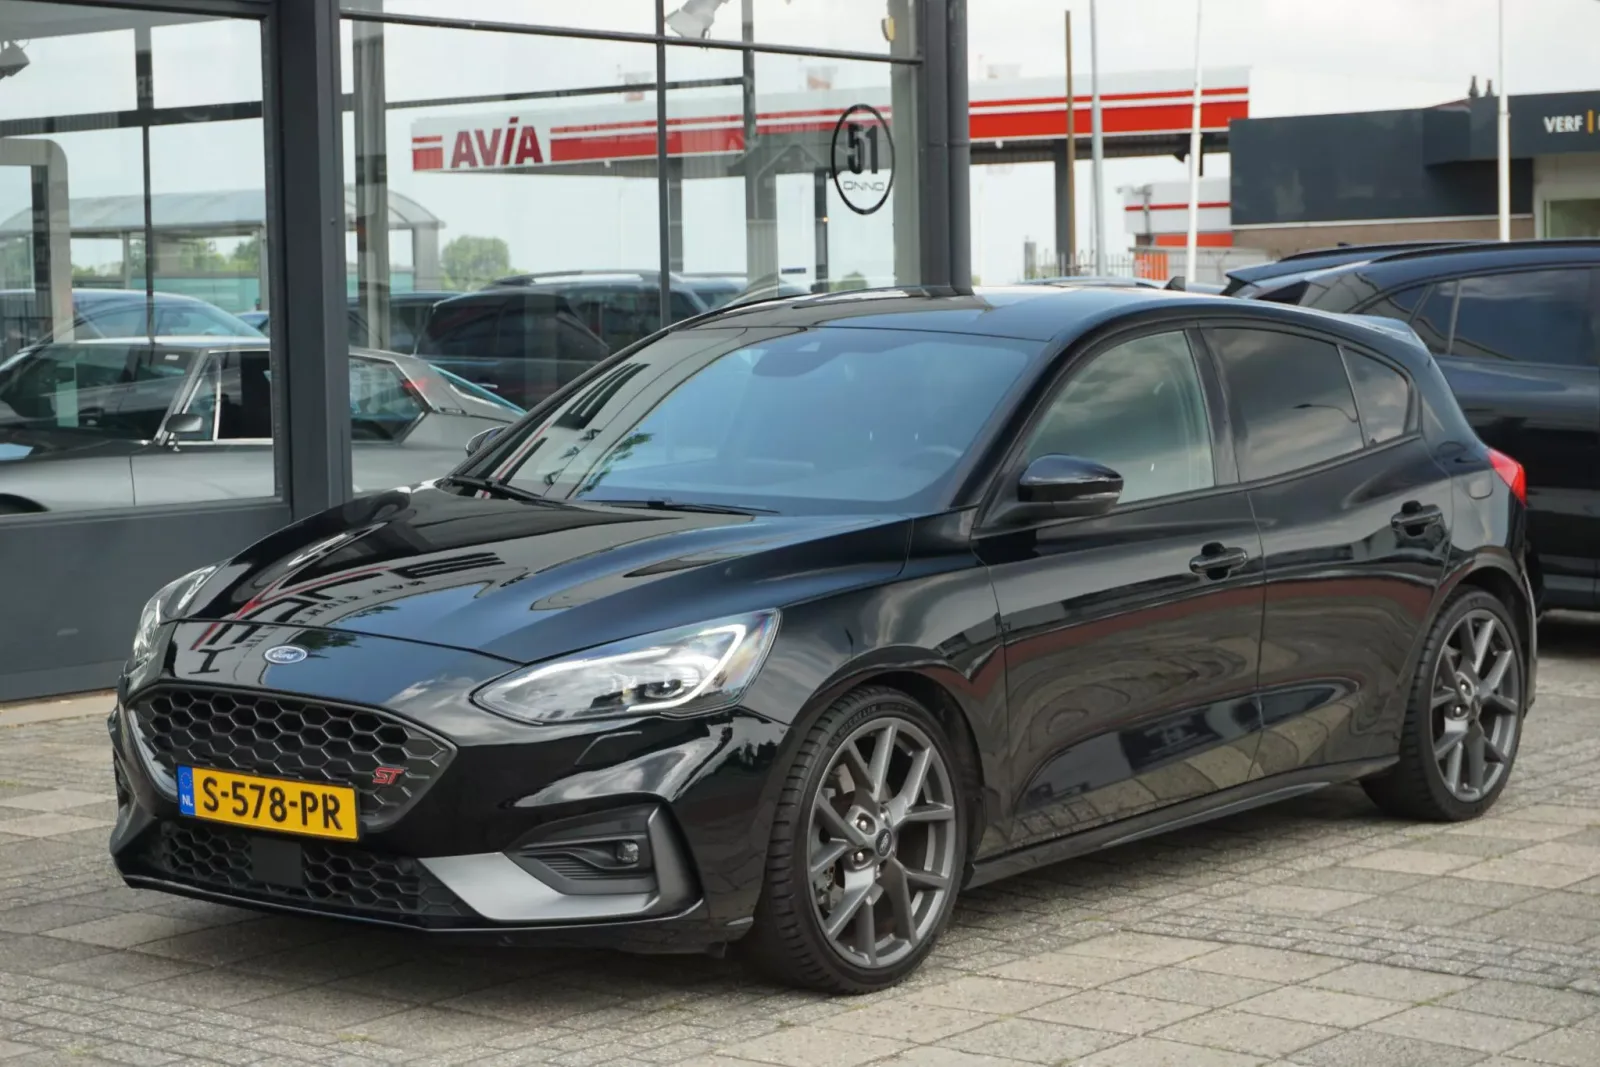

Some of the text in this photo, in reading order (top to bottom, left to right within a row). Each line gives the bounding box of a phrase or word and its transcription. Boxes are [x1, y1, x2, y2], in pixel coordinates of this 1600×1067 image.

[1543, 114, 1583, 133] VERF
[847, 123, 879, 175] 51
[372, 767, 405, 785] ST
[181, 794, 194, 807] NL
[202, 777, 343, 830] S-578-PR
